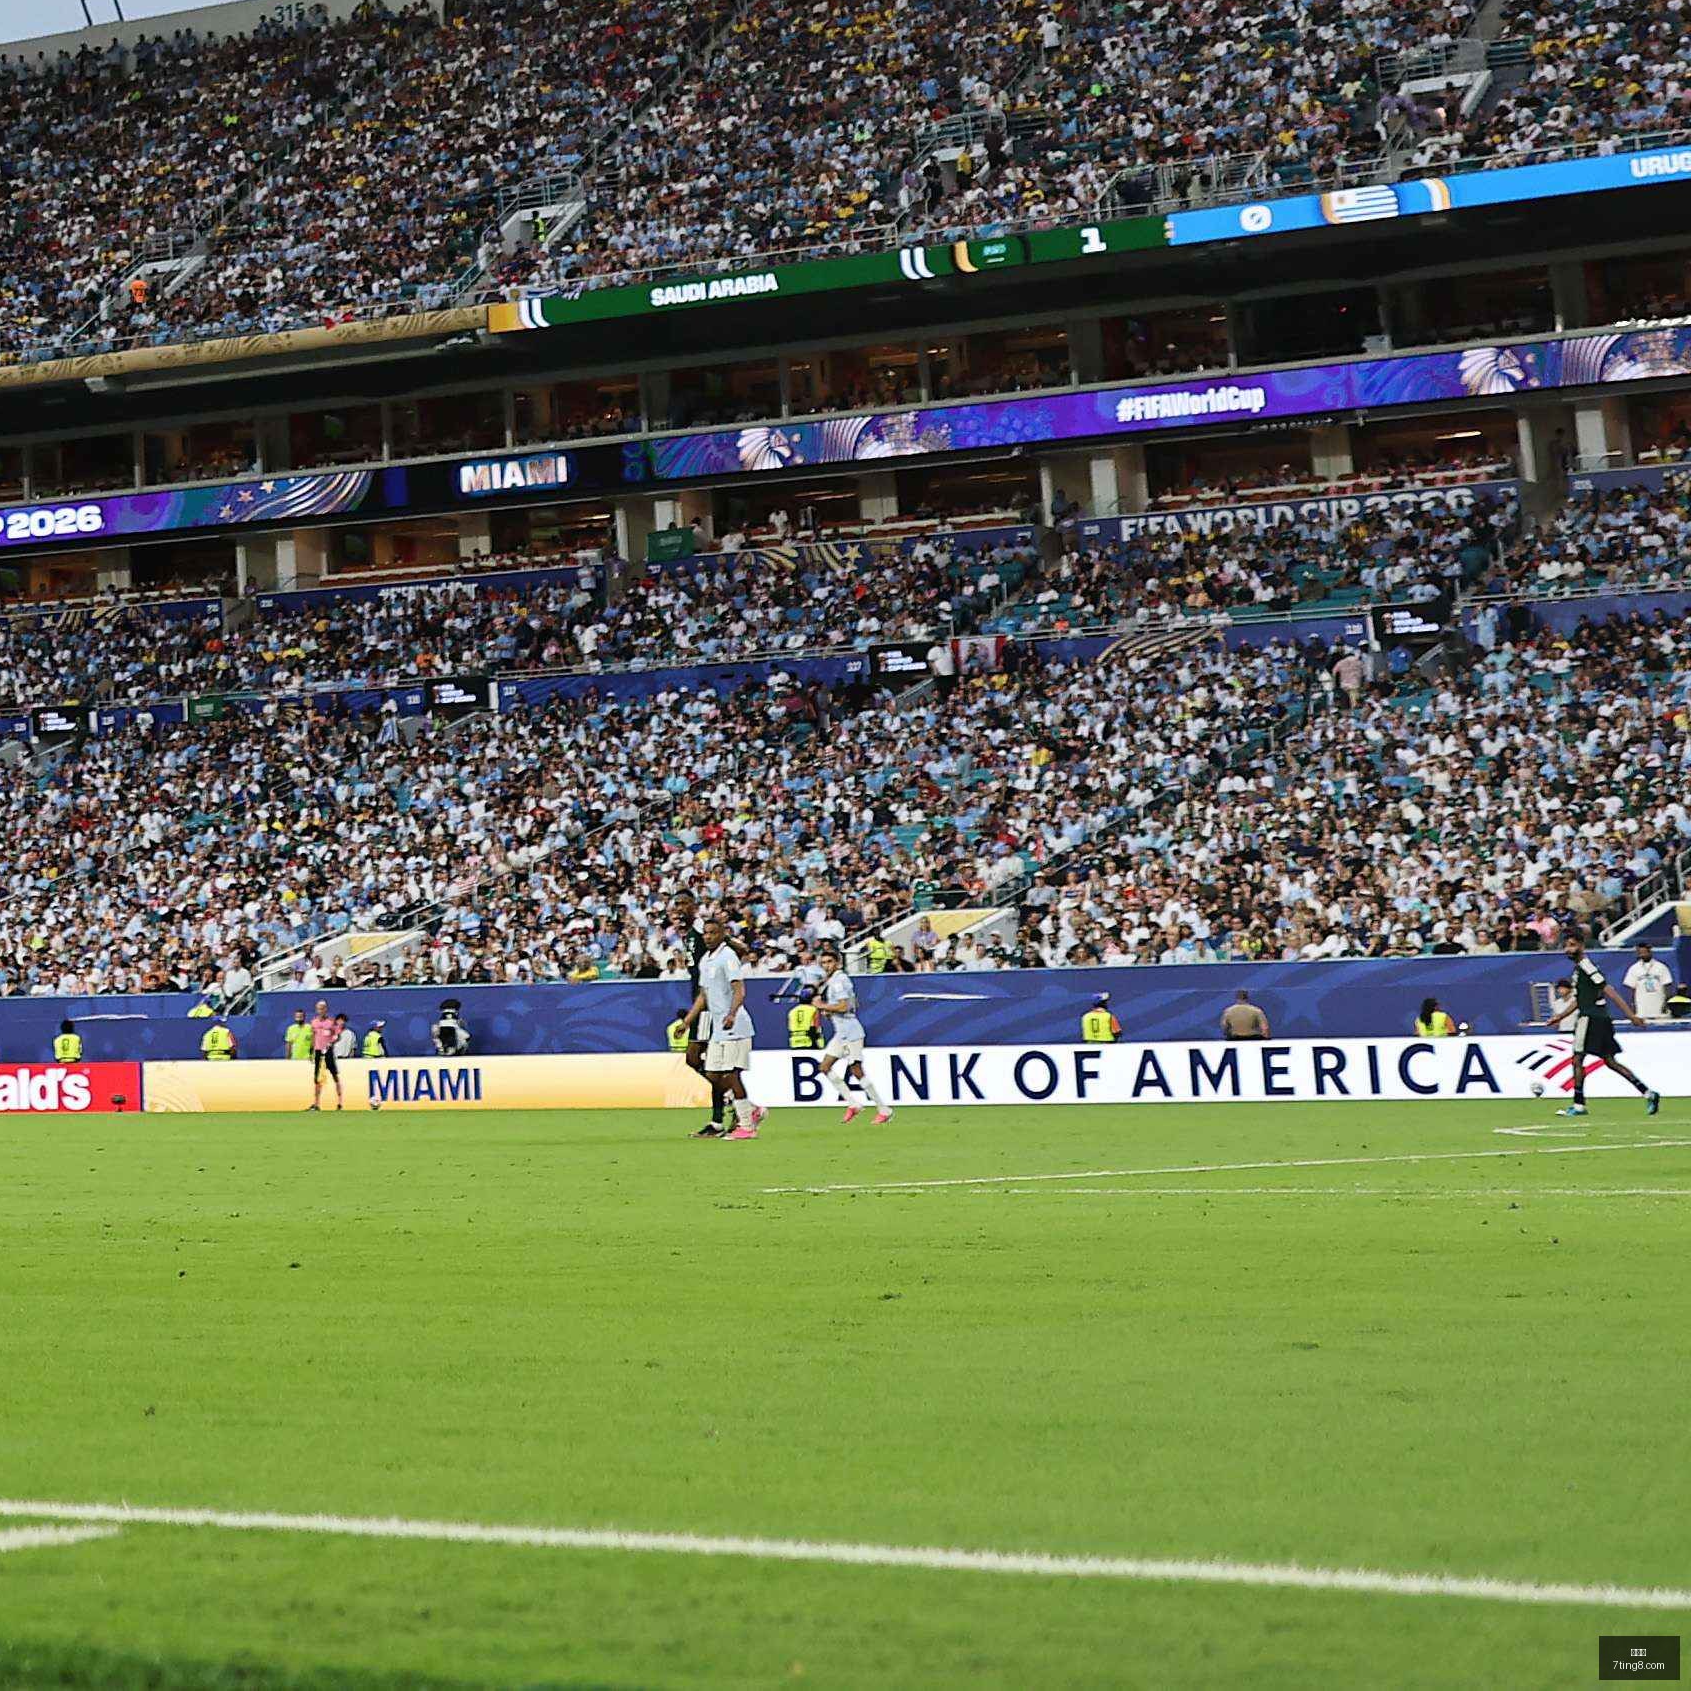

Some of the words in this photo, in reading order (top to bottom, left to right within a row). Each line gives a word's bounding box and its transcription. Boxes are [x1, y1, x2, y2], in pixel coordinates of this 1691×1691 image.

[1080, 227, 1107, 254] 1
[650, 281, 707, 307] SAUDI
[708, 272, 779, 300] ARABIA
[1116, 386, 1266, 423] #FIFAWorldCup
[460, 455, 568, 493] MIAMI
[5, 504, 103, 540] 2026
[368, 1068, 482, 1101] MIAMI
[791, 1051, 986, 1102] BNK
[1013, 1048, 1103, 1100] OF
[1132, 1042, 1503, 1098] AMERICA
